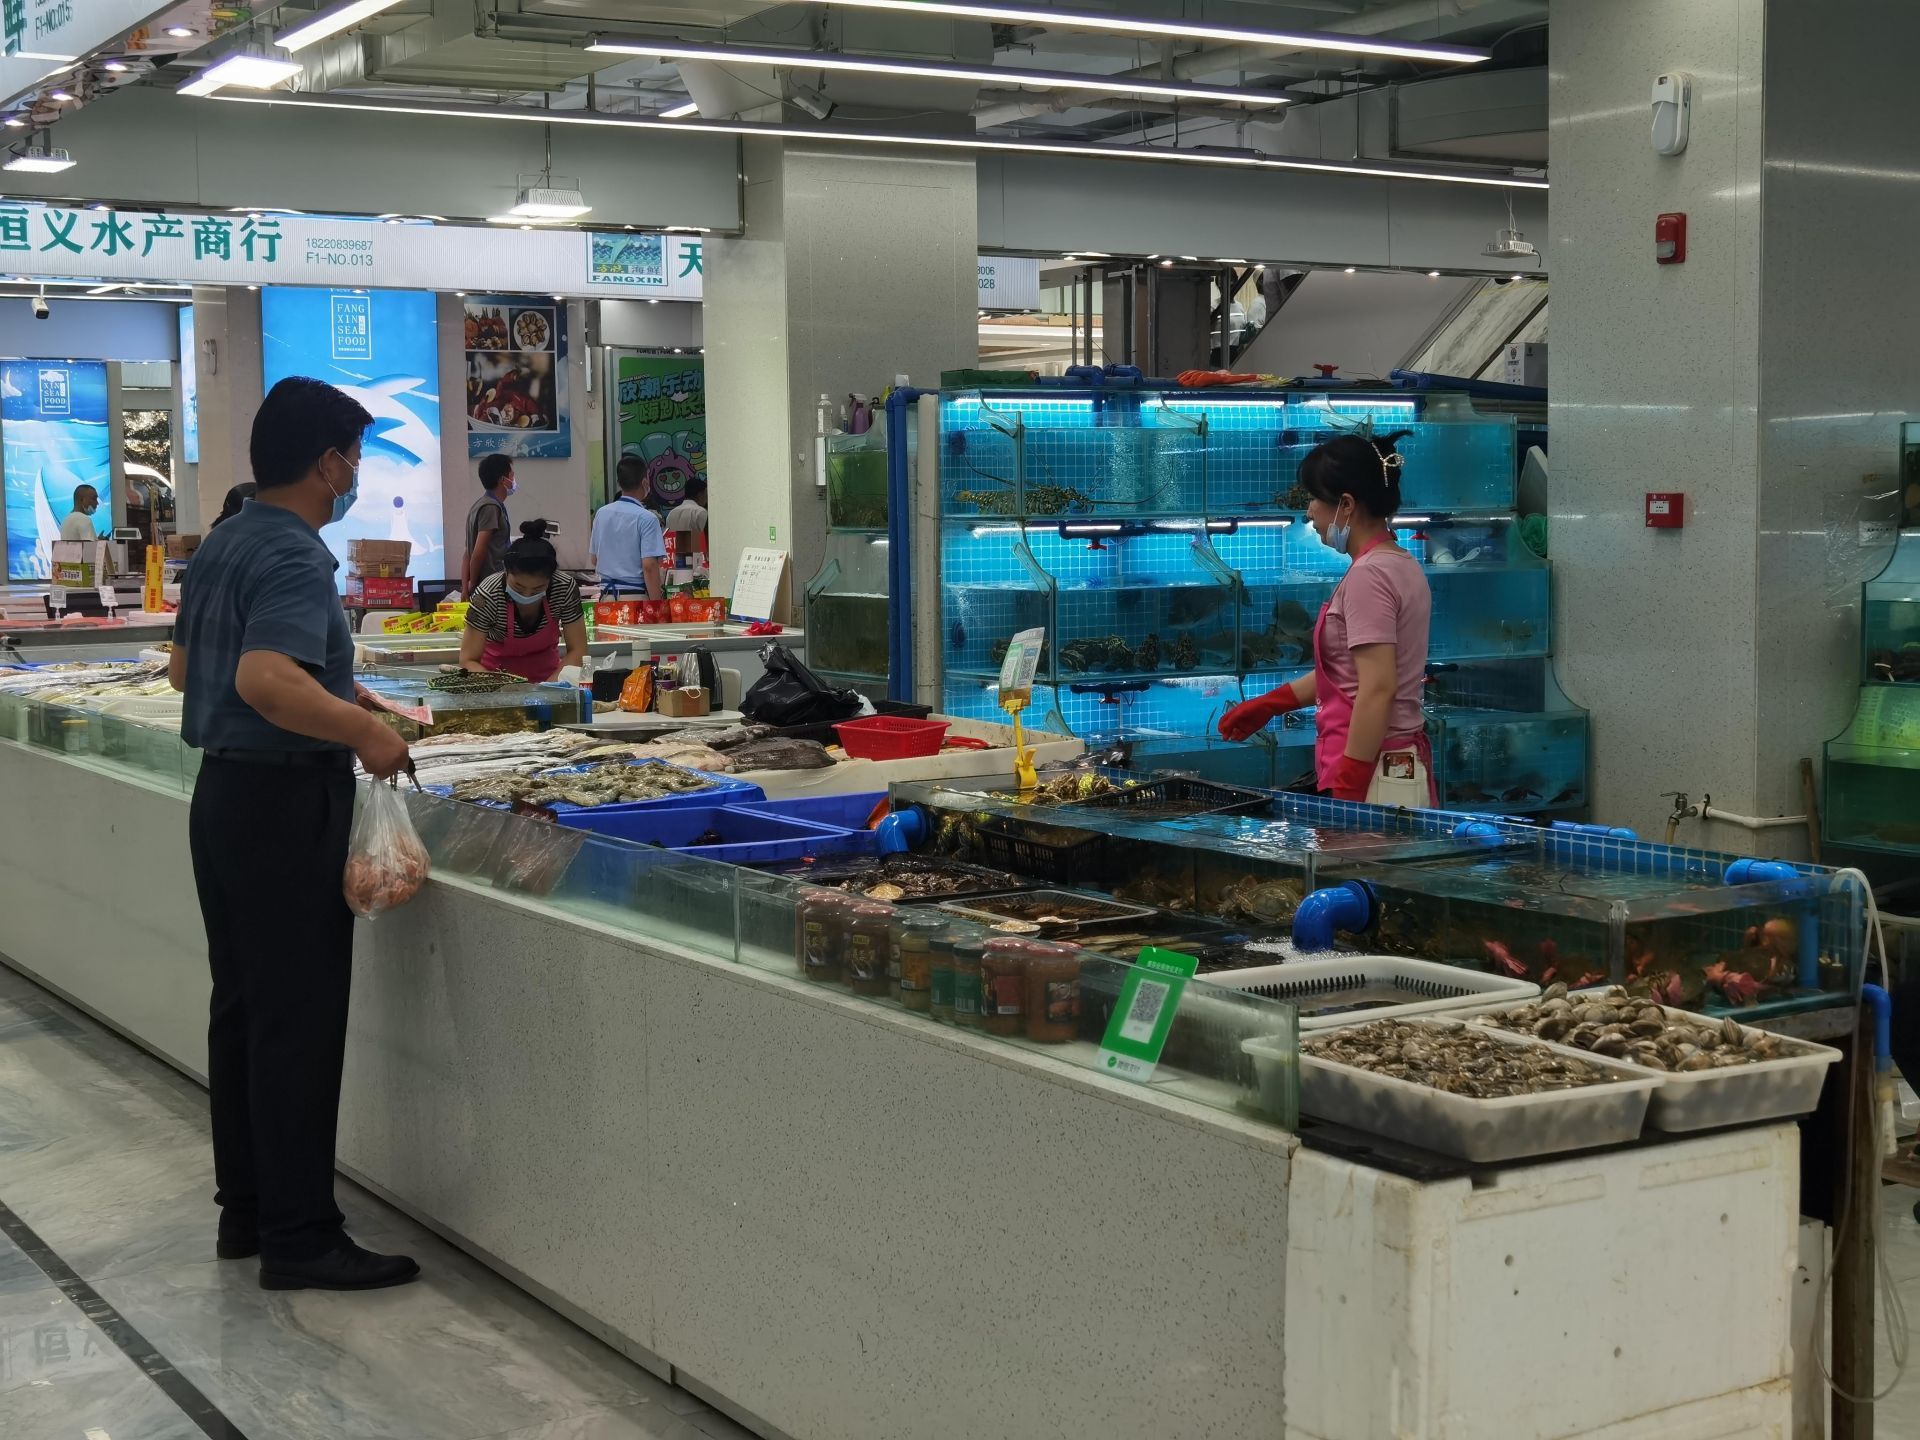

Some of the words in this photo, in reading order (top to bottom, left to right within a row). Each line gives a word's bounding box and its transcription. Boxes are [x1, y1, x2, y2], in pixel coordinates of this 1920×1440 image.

[305, 238, 373, 250] 18220839687
[306, 252, 373, 266] F1-NO.013
[593, 275, 663, 284] FANGXIN
[337, 303, 365, 313] FANG
[337, 314, 358, 324] XIN
[337, 325, 360, 335] SEA
[338, 336, 366, 346] FOOD
[43, 382, 60, 390] XIN
[44, 397, 66, 405] FOOD
